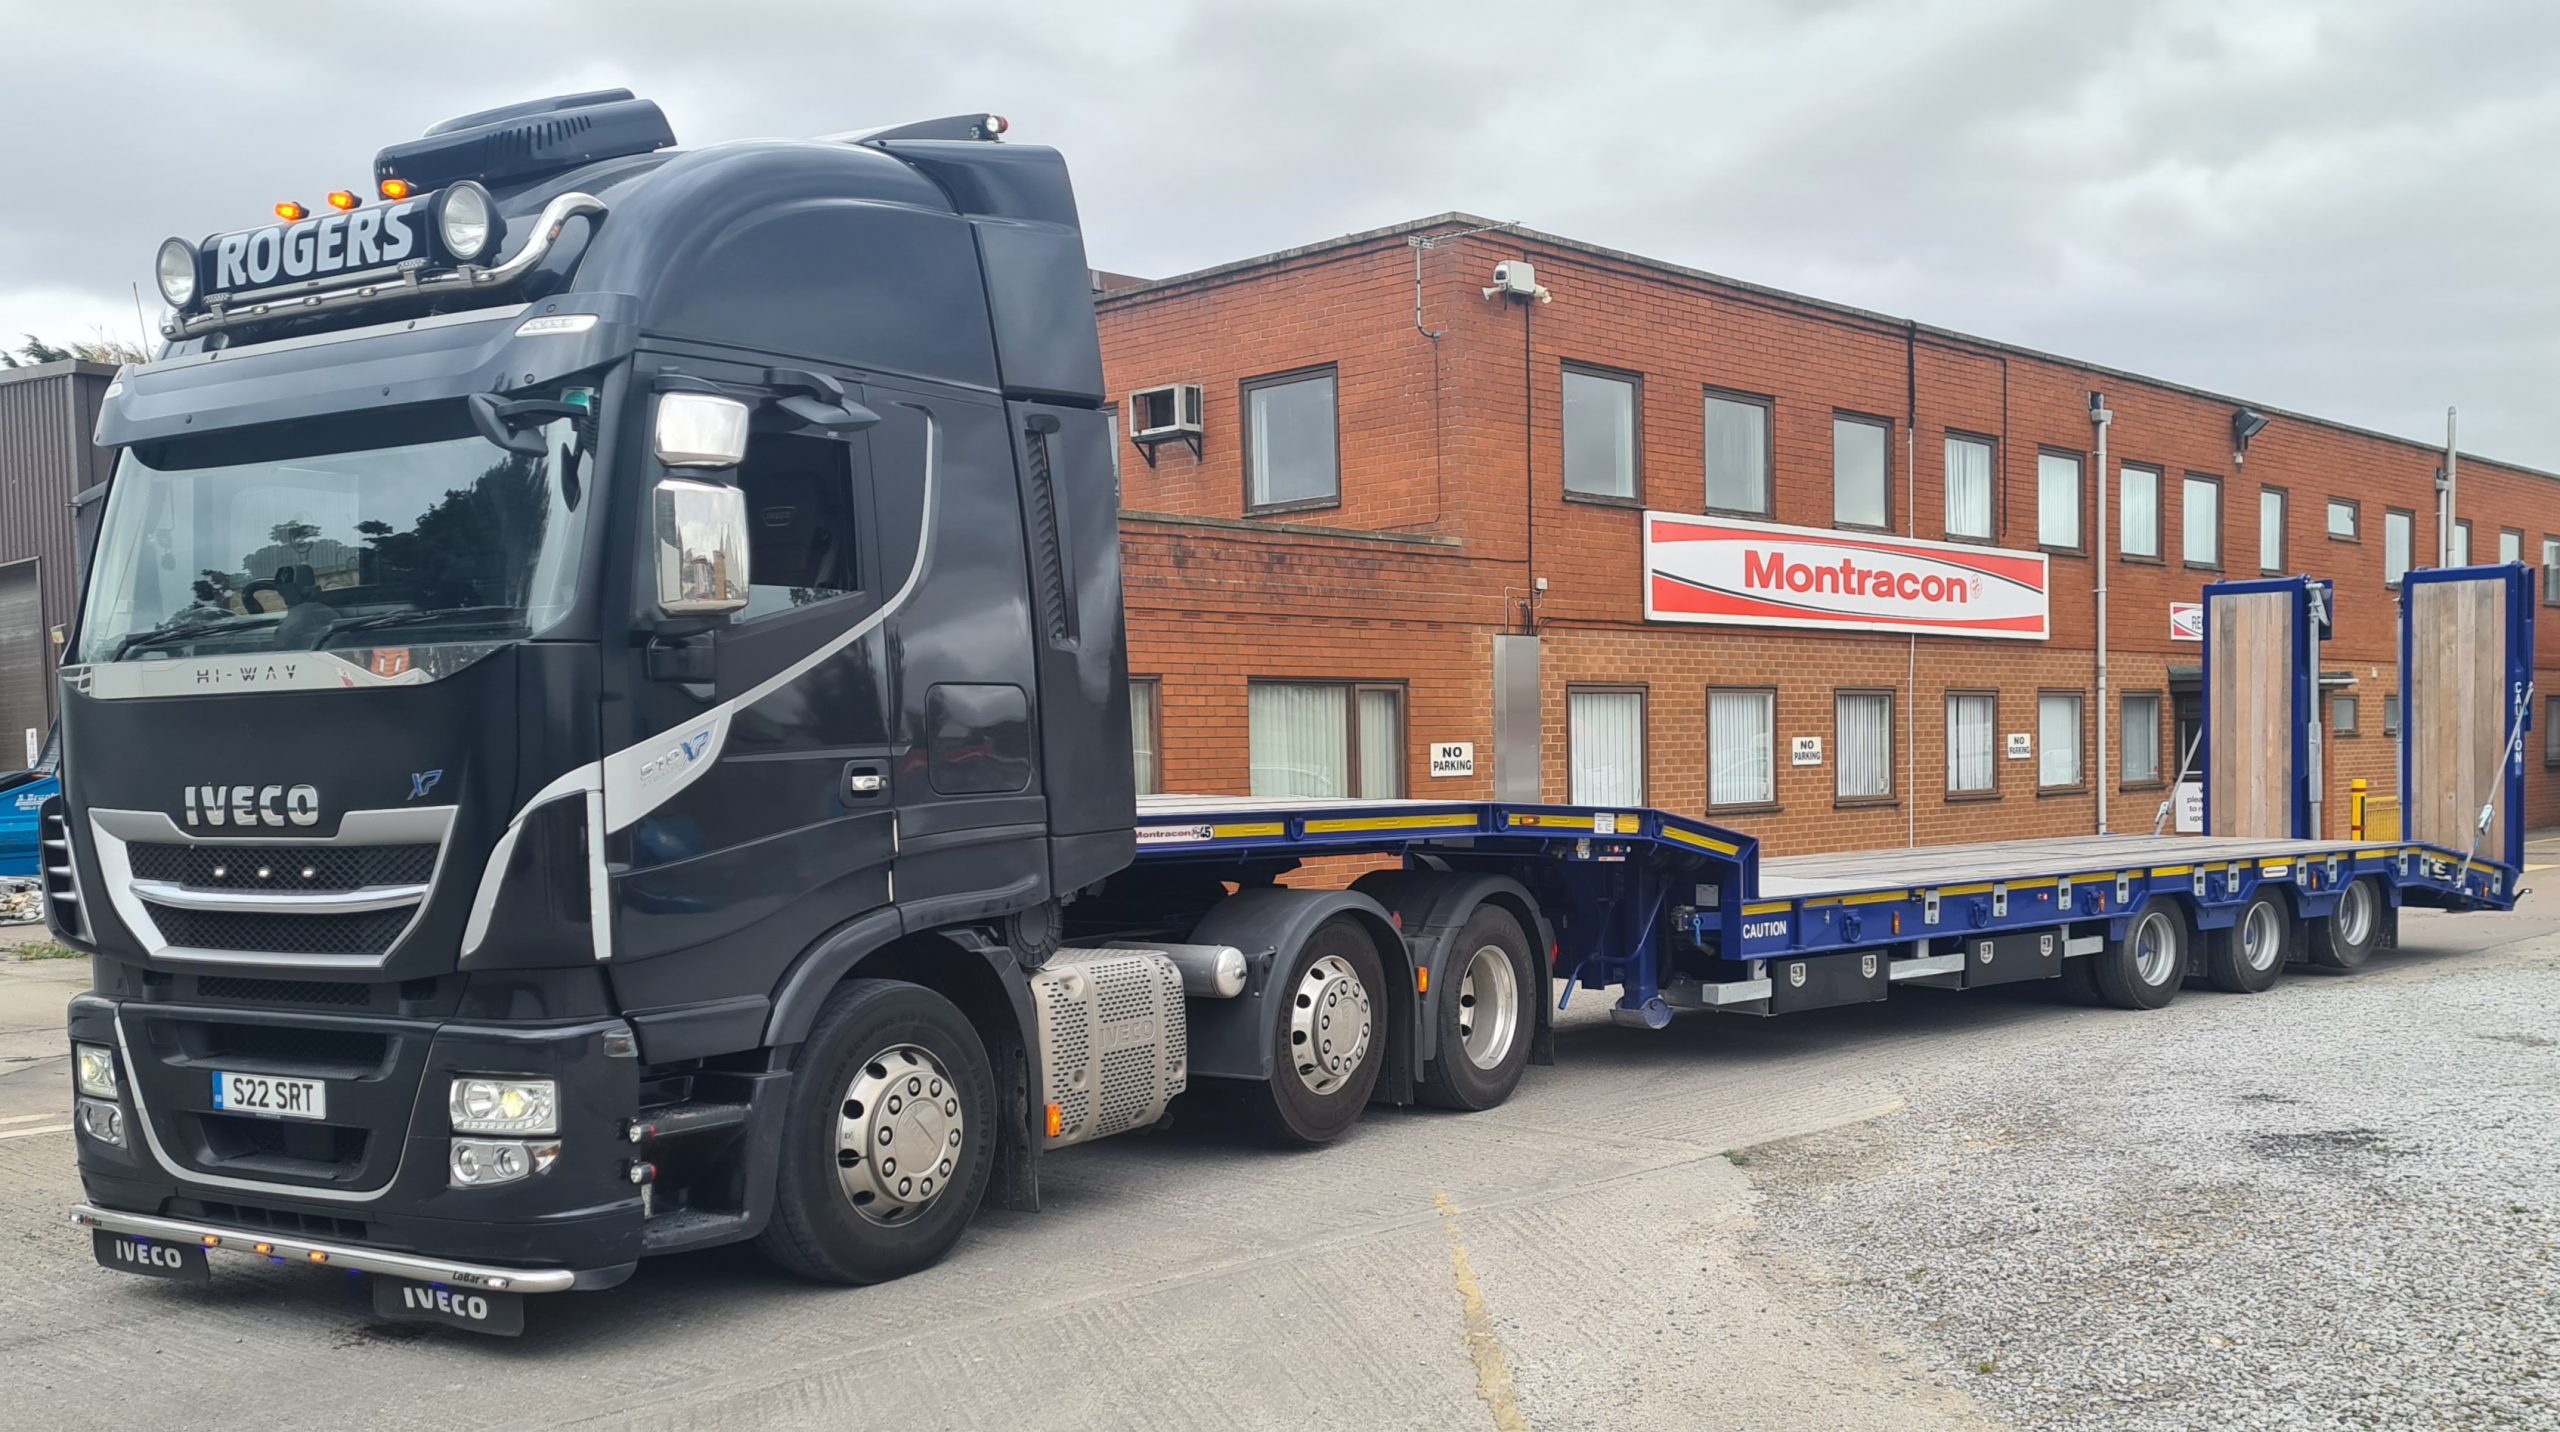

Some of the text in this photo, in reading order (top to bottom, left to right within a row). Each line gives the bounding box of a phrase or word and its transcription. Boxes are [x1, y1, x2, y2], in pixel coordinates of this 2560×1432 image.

[216, 202, 414, 289] ROGERS
[1745, 550, 1967, 603] Montracon
[1442, 746, 1463, 758] NO
[1794, 751, 1821, 760] PARKING
[1800, 740, 1815, 750] NO
[2013, 736, 2025, 745] NO
[1433, 760, 1472, 771] PARKING
[184, 784, 319, 826] IVECO
[1742, 920, 1787, 939] CAUTION
[1099, 1019, 1156, 1049] IVECO
[233, 1077, 313, 1112] S22 SRT
[115, 1239, 182, 1269] IVECO
[403, 1286, 488, 1320] IVECO
